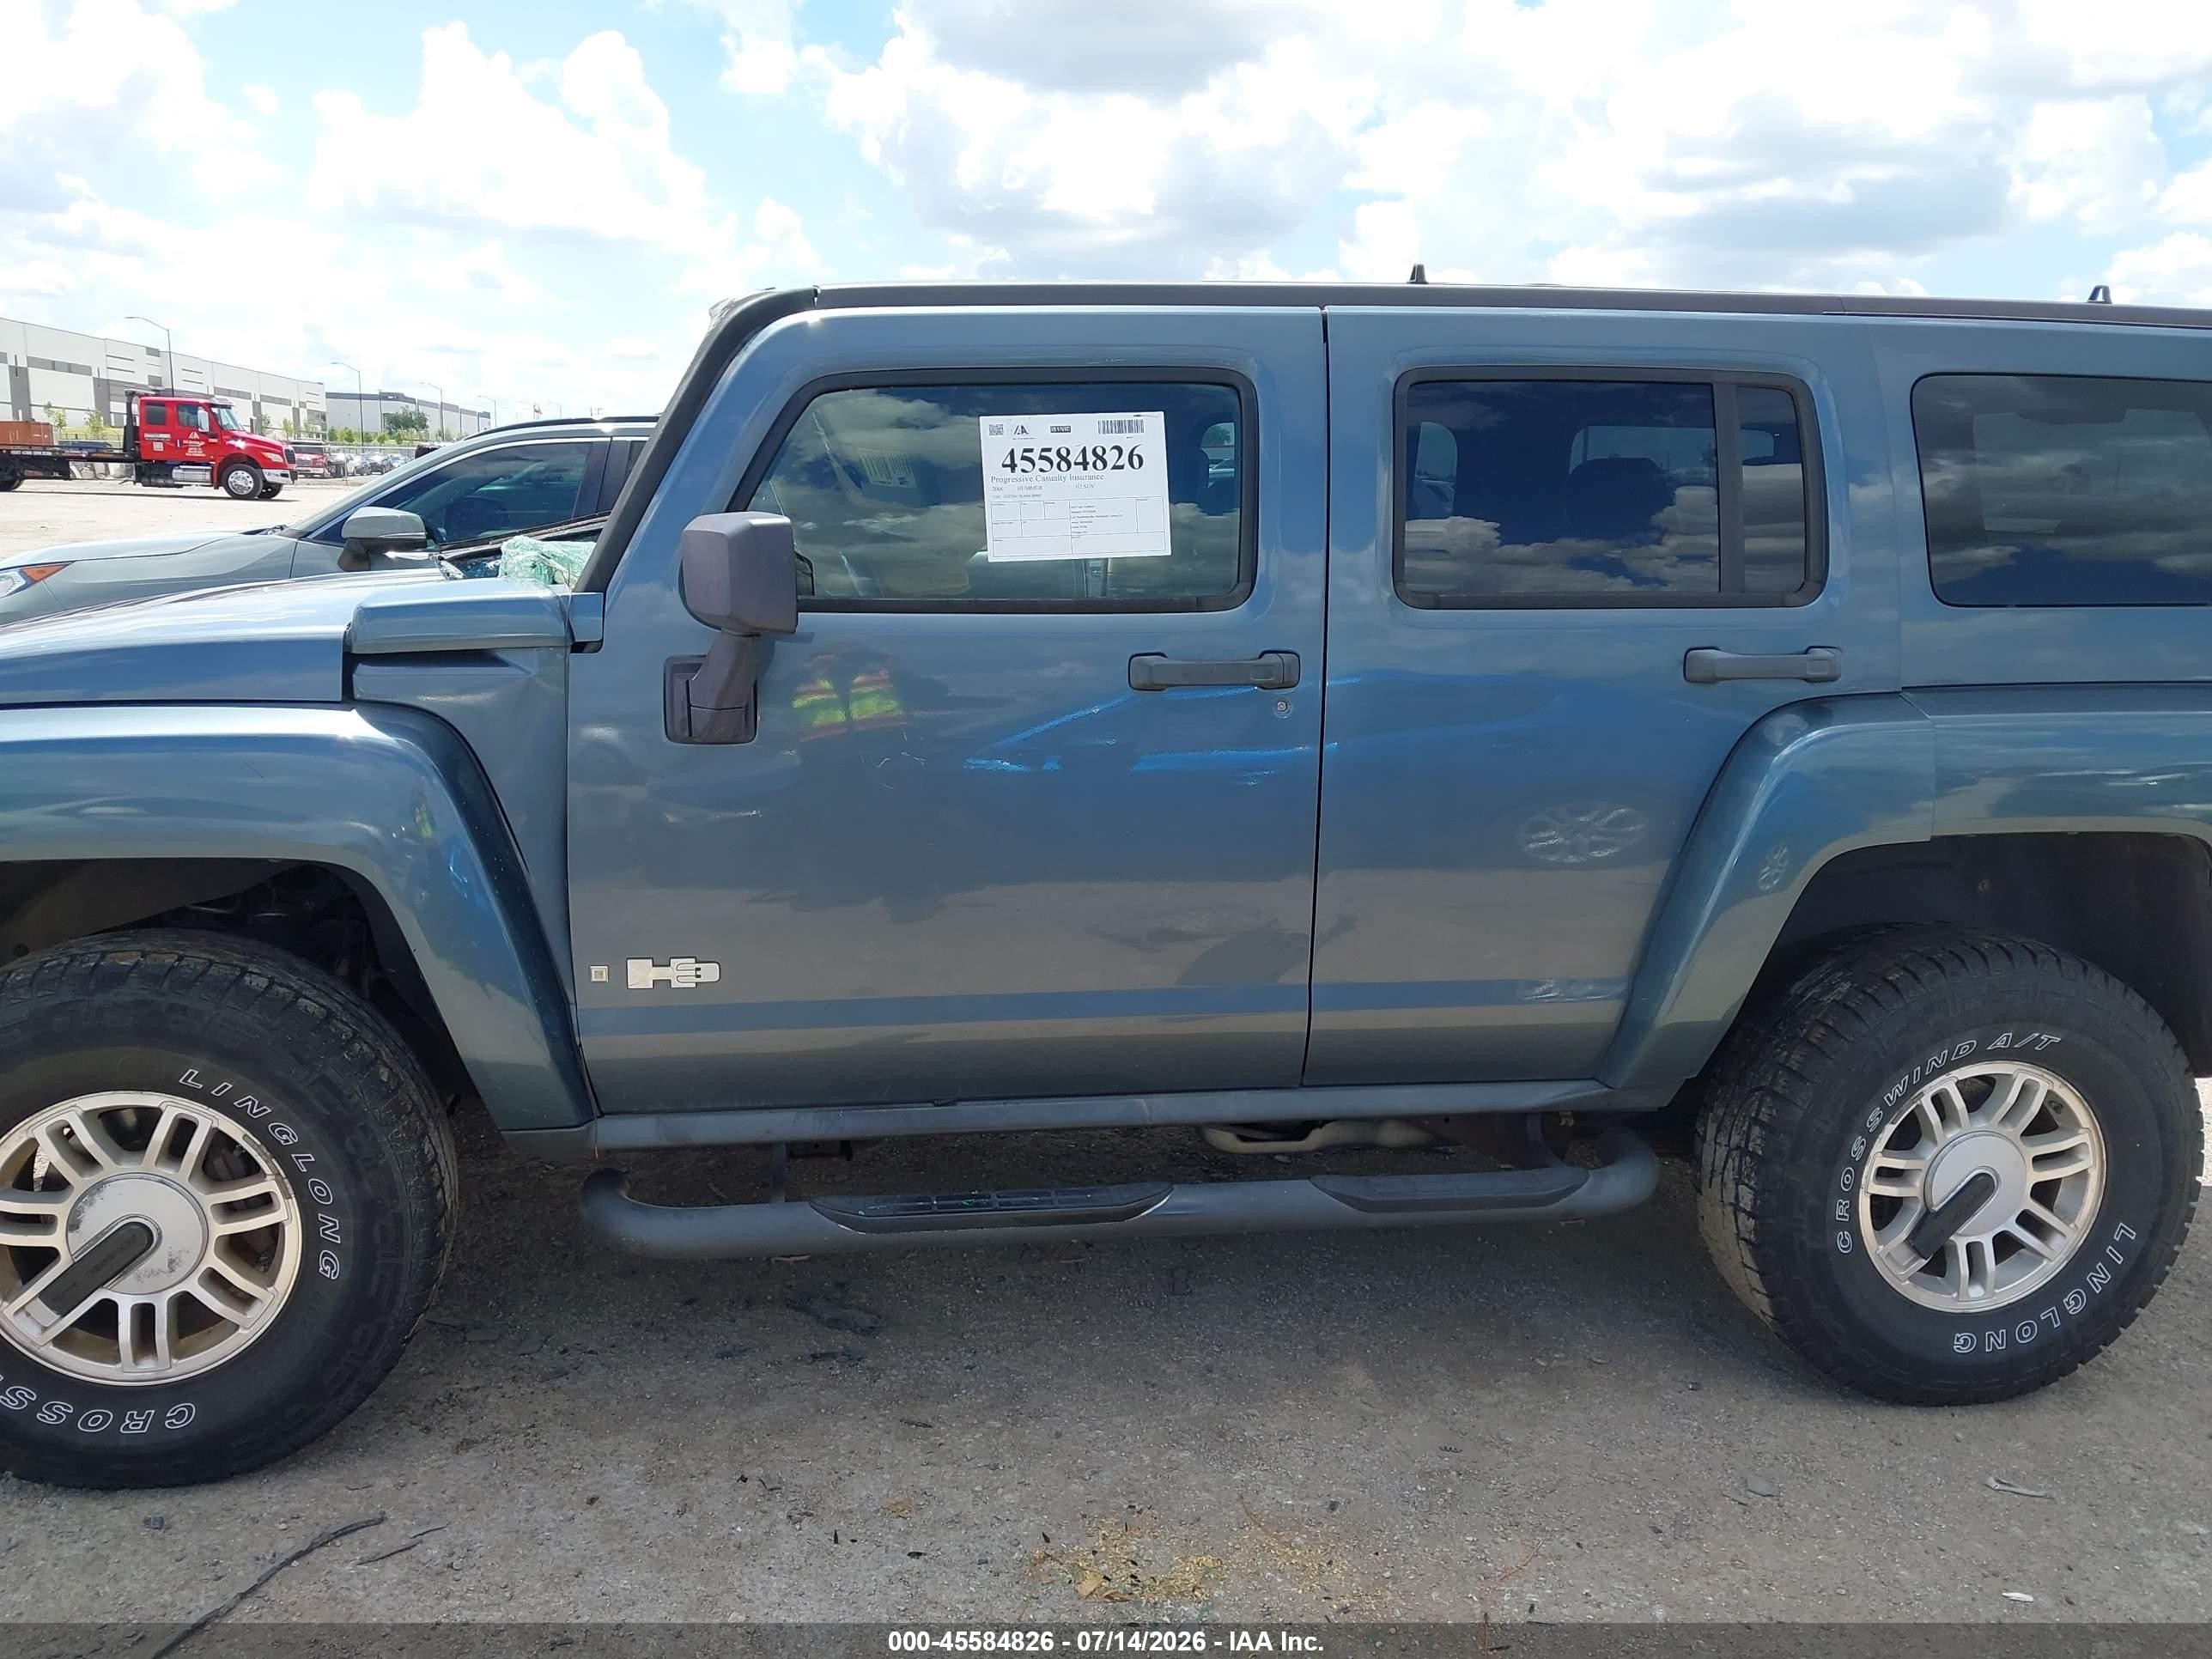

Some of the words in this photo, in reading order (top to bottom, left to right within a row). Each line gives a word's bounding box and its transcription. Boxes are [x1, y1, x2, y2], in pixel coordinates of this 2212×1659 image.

[991, 475, 1034, 485] Progressive
[1036, 474, 1066, 483] Casualty
[1069, 473, 1104, 482] Insurance
[1001, 444, 1145, 473] 45584826
[179, 1068, 342, 1280] LINGLONG
[1836, 1040, 1978, 1254] CROSSWIND
[1986, 1032, 2062, 1051] A/T
[1953, 1222, 2136, 1353] LINGLONG
[0, 1375, 197, 1434] CROSS
